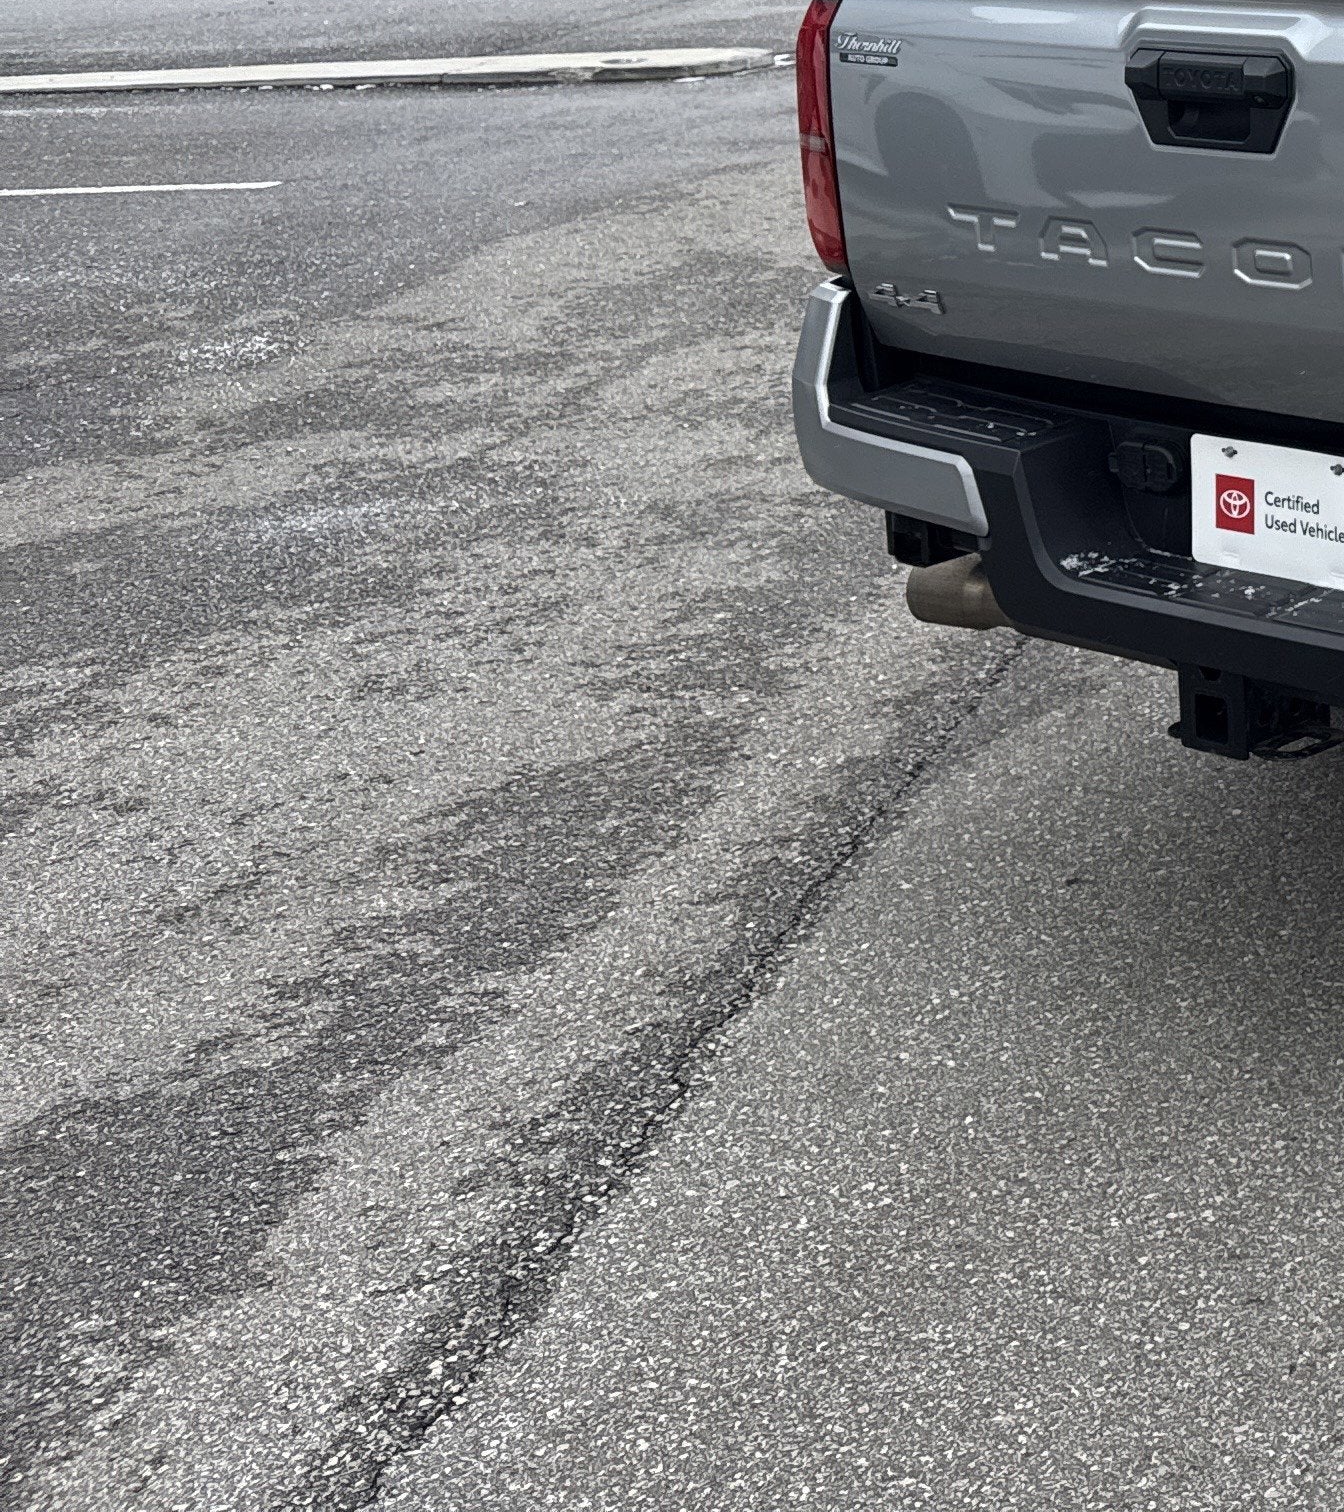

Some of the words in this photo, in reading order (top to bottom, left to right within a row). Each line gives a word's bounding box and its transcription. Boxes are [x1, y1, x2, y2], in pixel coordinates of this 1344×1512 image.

[835, 32, 901, 53] Thornhill
[1161, 66, 1240, 92] TOYOTA
[1264, 491, 1320, 515] Certified
[1264, 514, 1297, 534] Used
